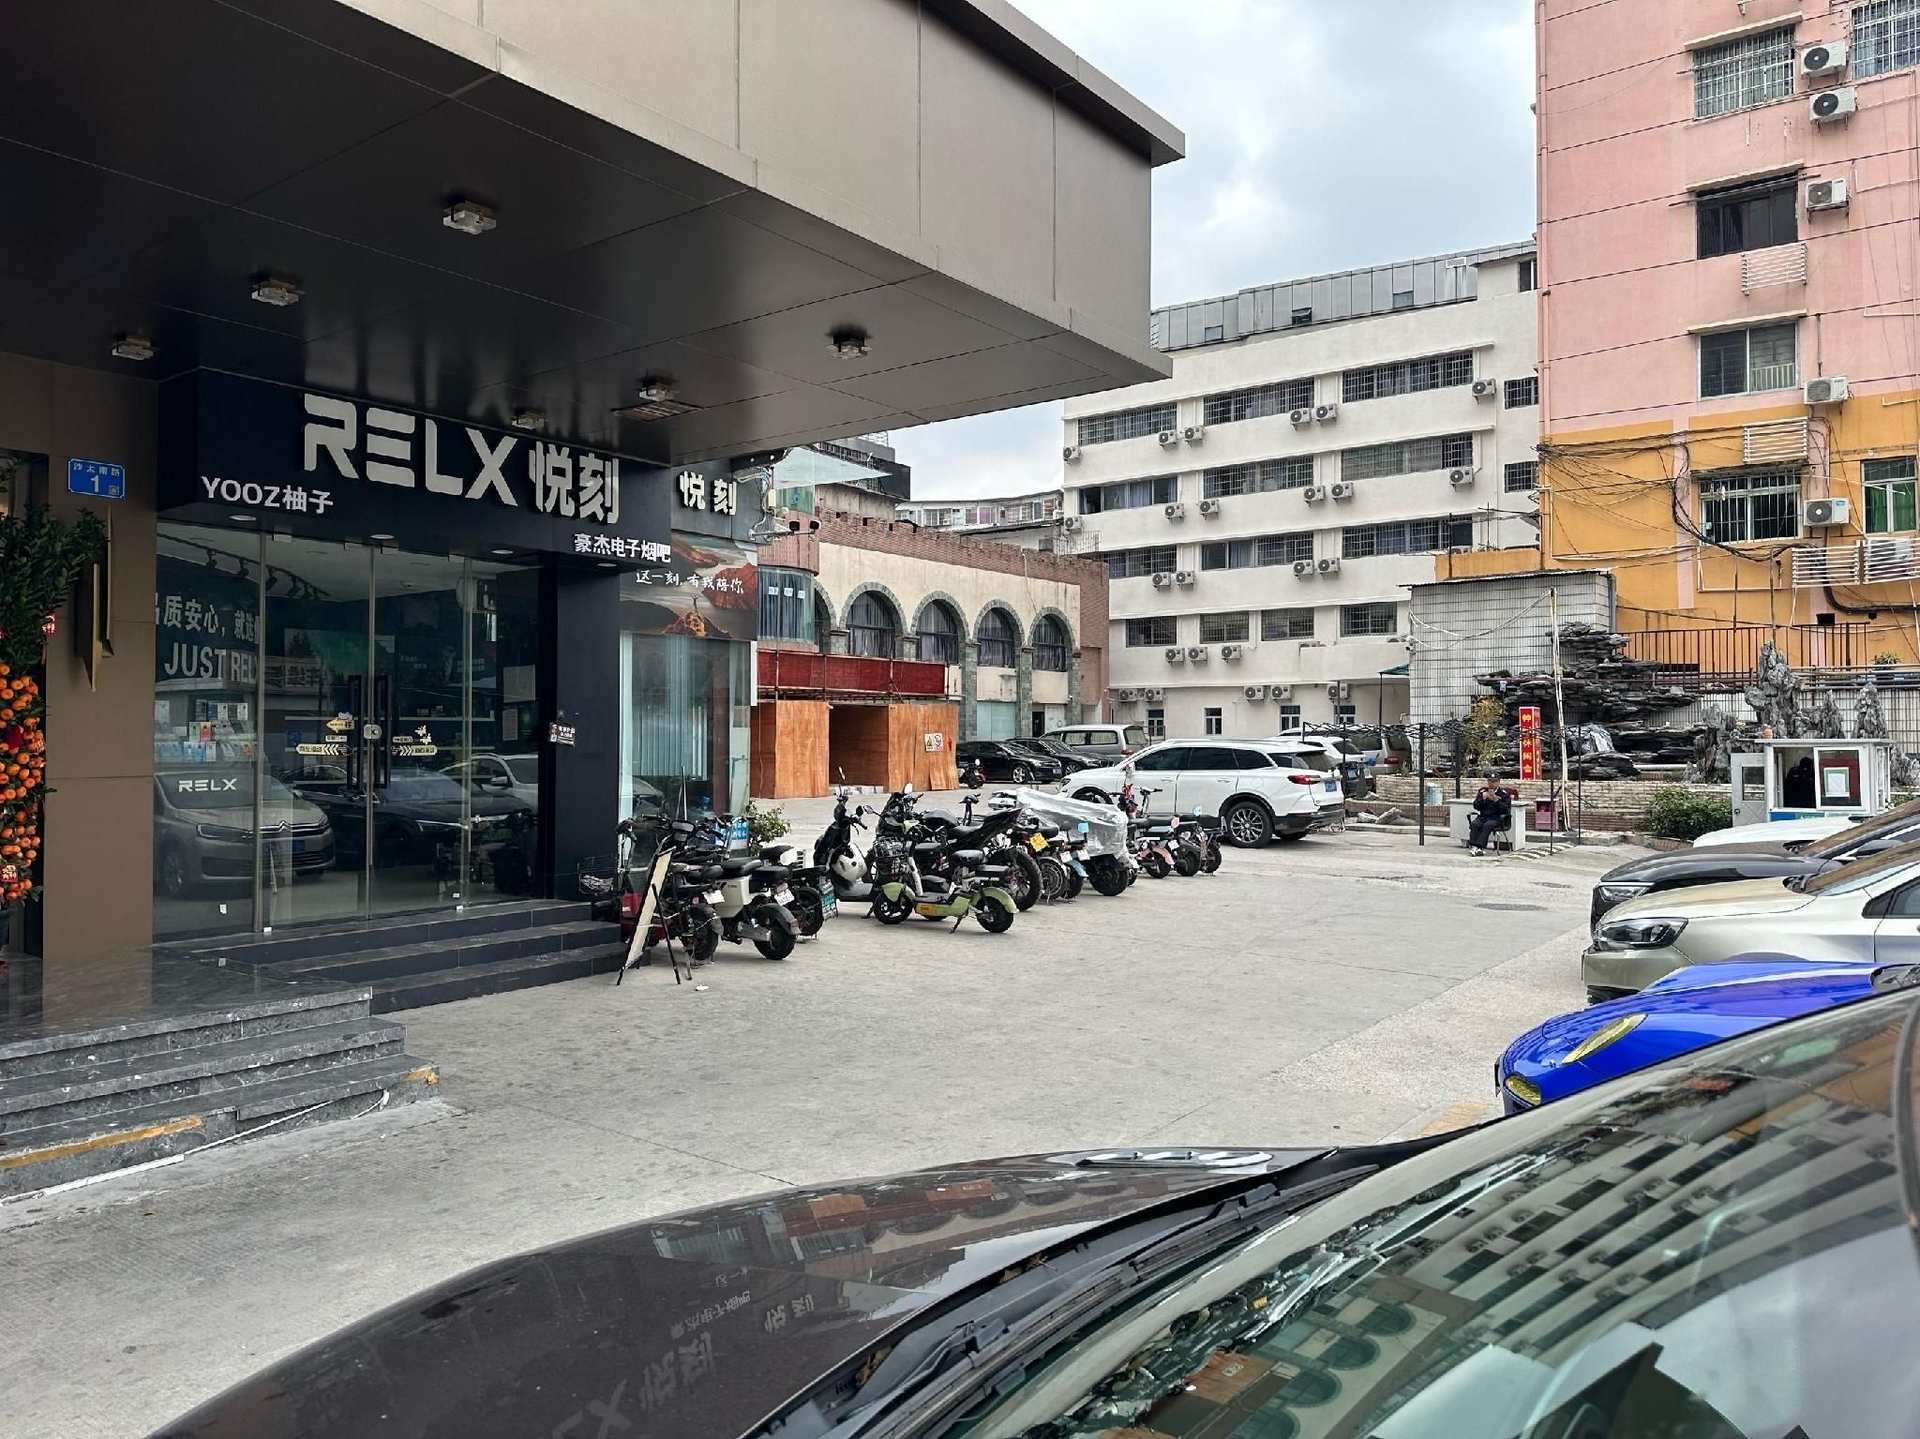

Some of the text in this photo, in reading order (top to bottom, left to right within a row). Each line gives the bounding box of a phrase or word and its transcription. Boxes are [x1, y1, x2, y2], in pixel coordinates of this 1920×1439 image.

[304, 393, 619, 524] RELX 悦刻
[90, 475, 99, 493] 1
[679, 471, 738, 516] 悦刻
[574, 532, 672, 564] 豪杰电子烟吧
[164, 642, 227, 680] JUST
[178, 778, 238, 793] RELX
